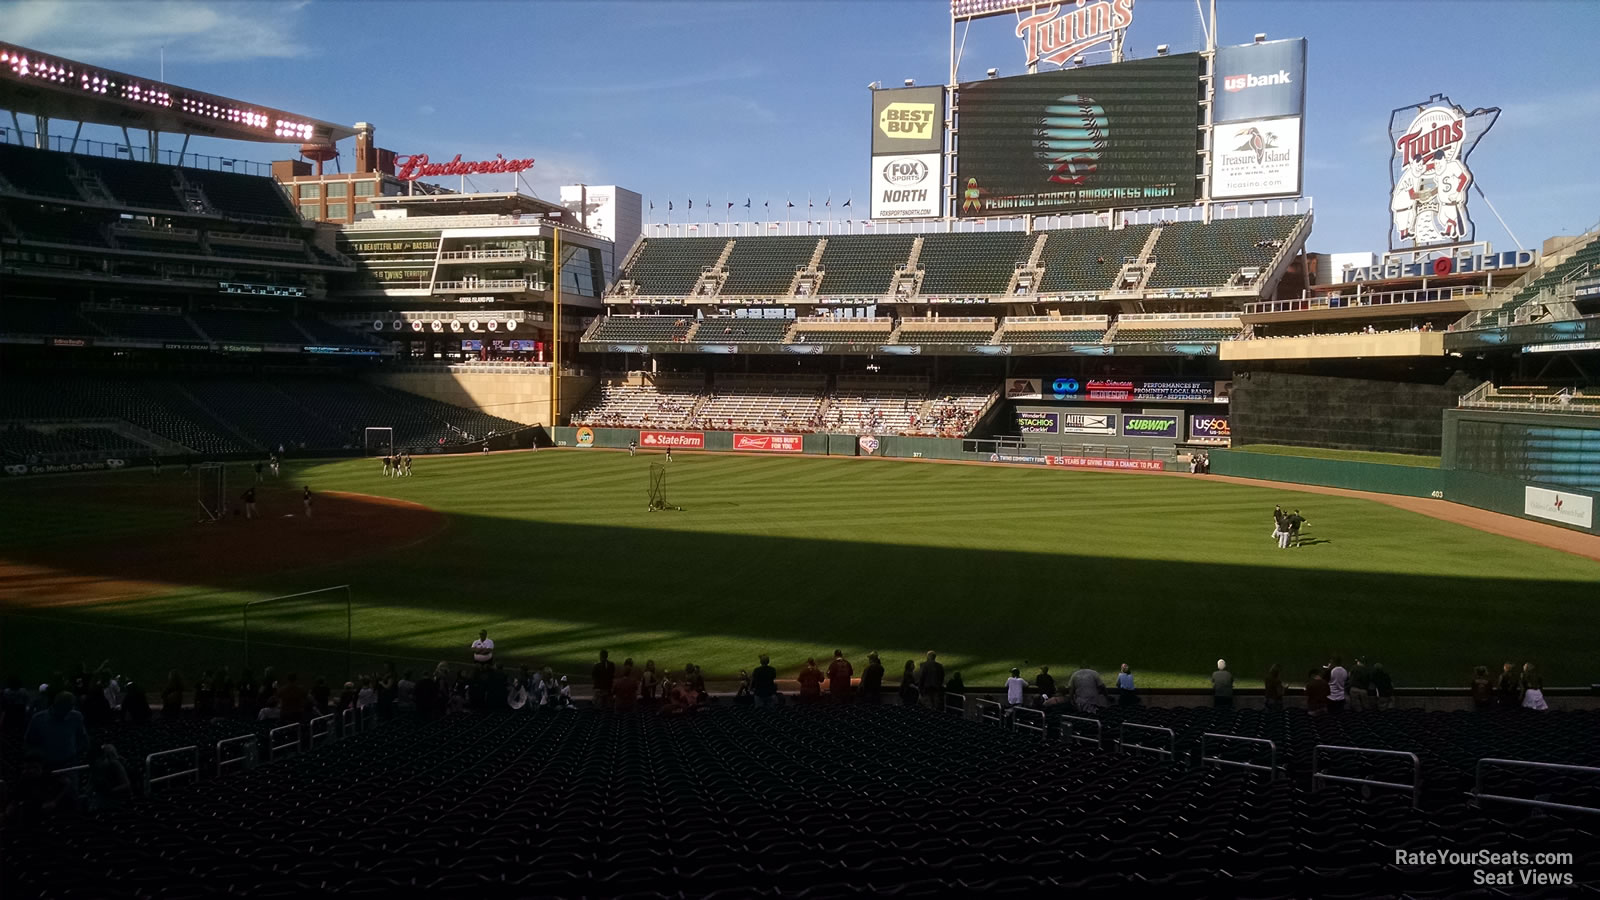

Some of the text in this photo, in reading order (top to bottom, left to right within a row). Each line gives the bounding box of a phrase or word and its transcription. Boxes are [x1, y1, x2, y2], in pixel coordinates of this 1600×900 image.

[1016, 0, 1134, 66] Twins
[1225, 70, 1291, 90] usbank
[887, 109, 933, 121] BEST
[888, 121, 928, 133] BUY
[1397, 119, 1464, 168] Twins
[1220, 149, 1290, 166] Treasure Island
[393, 153, 535, 181] Budweiser
[892, 162, 919, 176] FOX
[1227, 180, 1282, 189] ticasino.com
[1442, 175, 1452, 193] S
[883, 189, 927, 203] NORTH
[986, 182, 1177, 210] PEDIATRIC CANCER AWARENESS NIGHT
[880, 209, 931, 217] FOXSPORTSNORTH.COM
[364, 243, 392, 251] BEAUTIFUL
[412, 241, 438, 250] BASEBALL
[1342, 250, 1537, 284] TARGET FIELD
[384, 270, 403, 280] TWINS
[1090, 390, 1129, 400] WEDNESDAY
[1125, 419, 1176, 431] SUBWAY
[868, 440, 879, 448] 29
[46, 463, 70, 473] Music
[83, 461, 105, 470] Twins
[1054, 456, 1064, 465] 25
[1120, 460, 1139, 468] CHANCE
[1139, 461, 1147, 469] TO
[1431, 490, 1443, 498] 403
